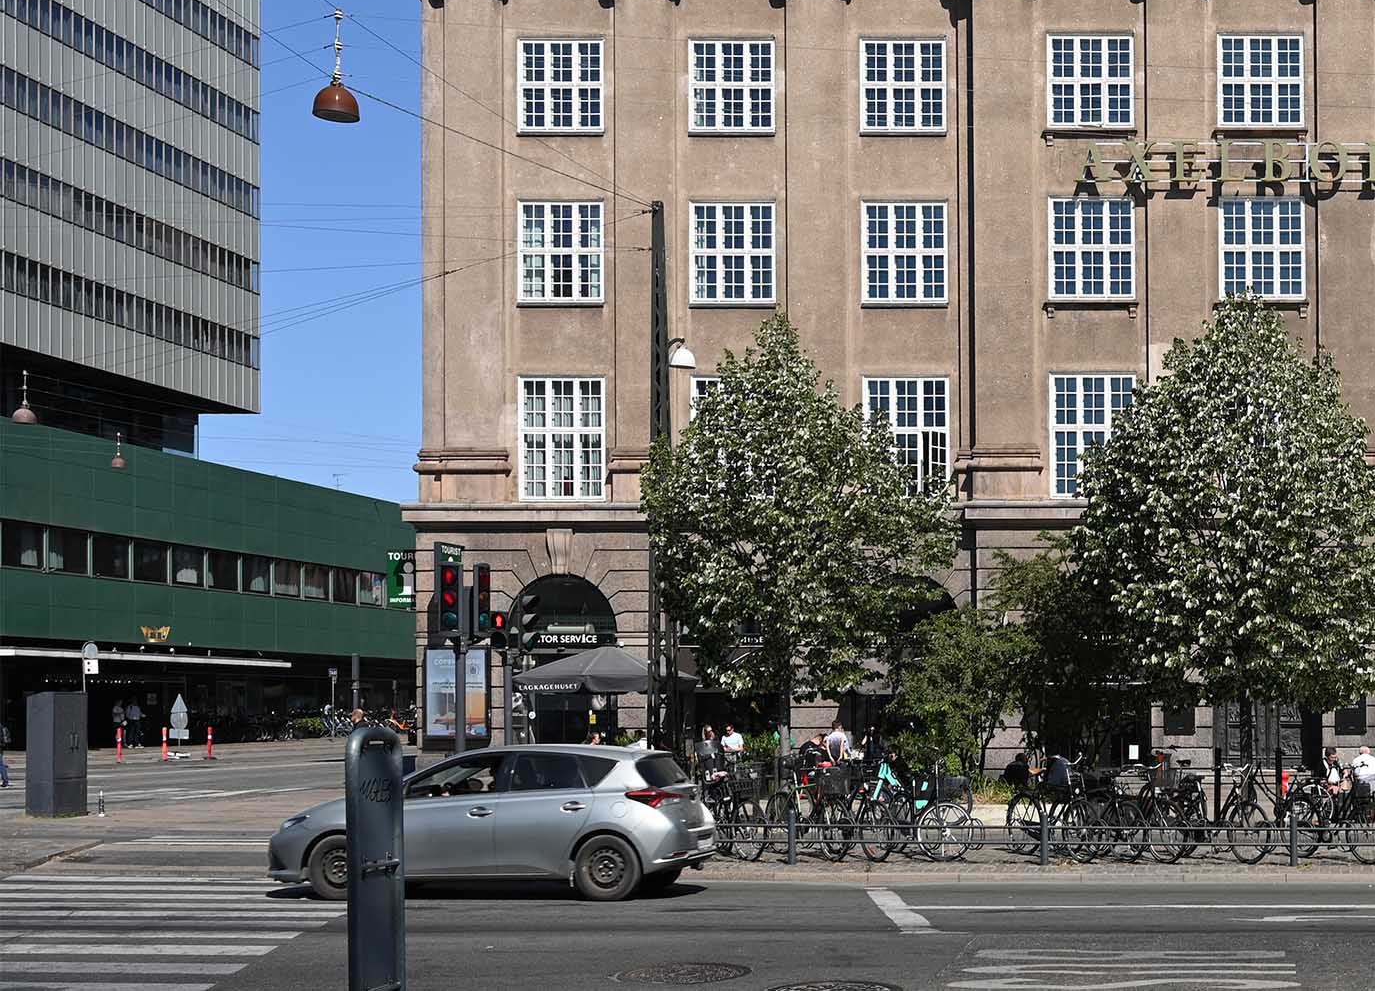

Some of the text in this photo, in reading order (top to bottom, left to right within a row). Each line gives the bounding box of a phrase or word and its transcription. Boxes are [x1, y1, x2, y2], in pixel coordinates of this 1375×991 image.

[441, 545, 461, 556] TOURIST
[387, 552, 416, 561] TOUR
[537, 634, 598, 644] TOR SERVICE
[518, 683, 578, 691] LAGKAGEHUSET
